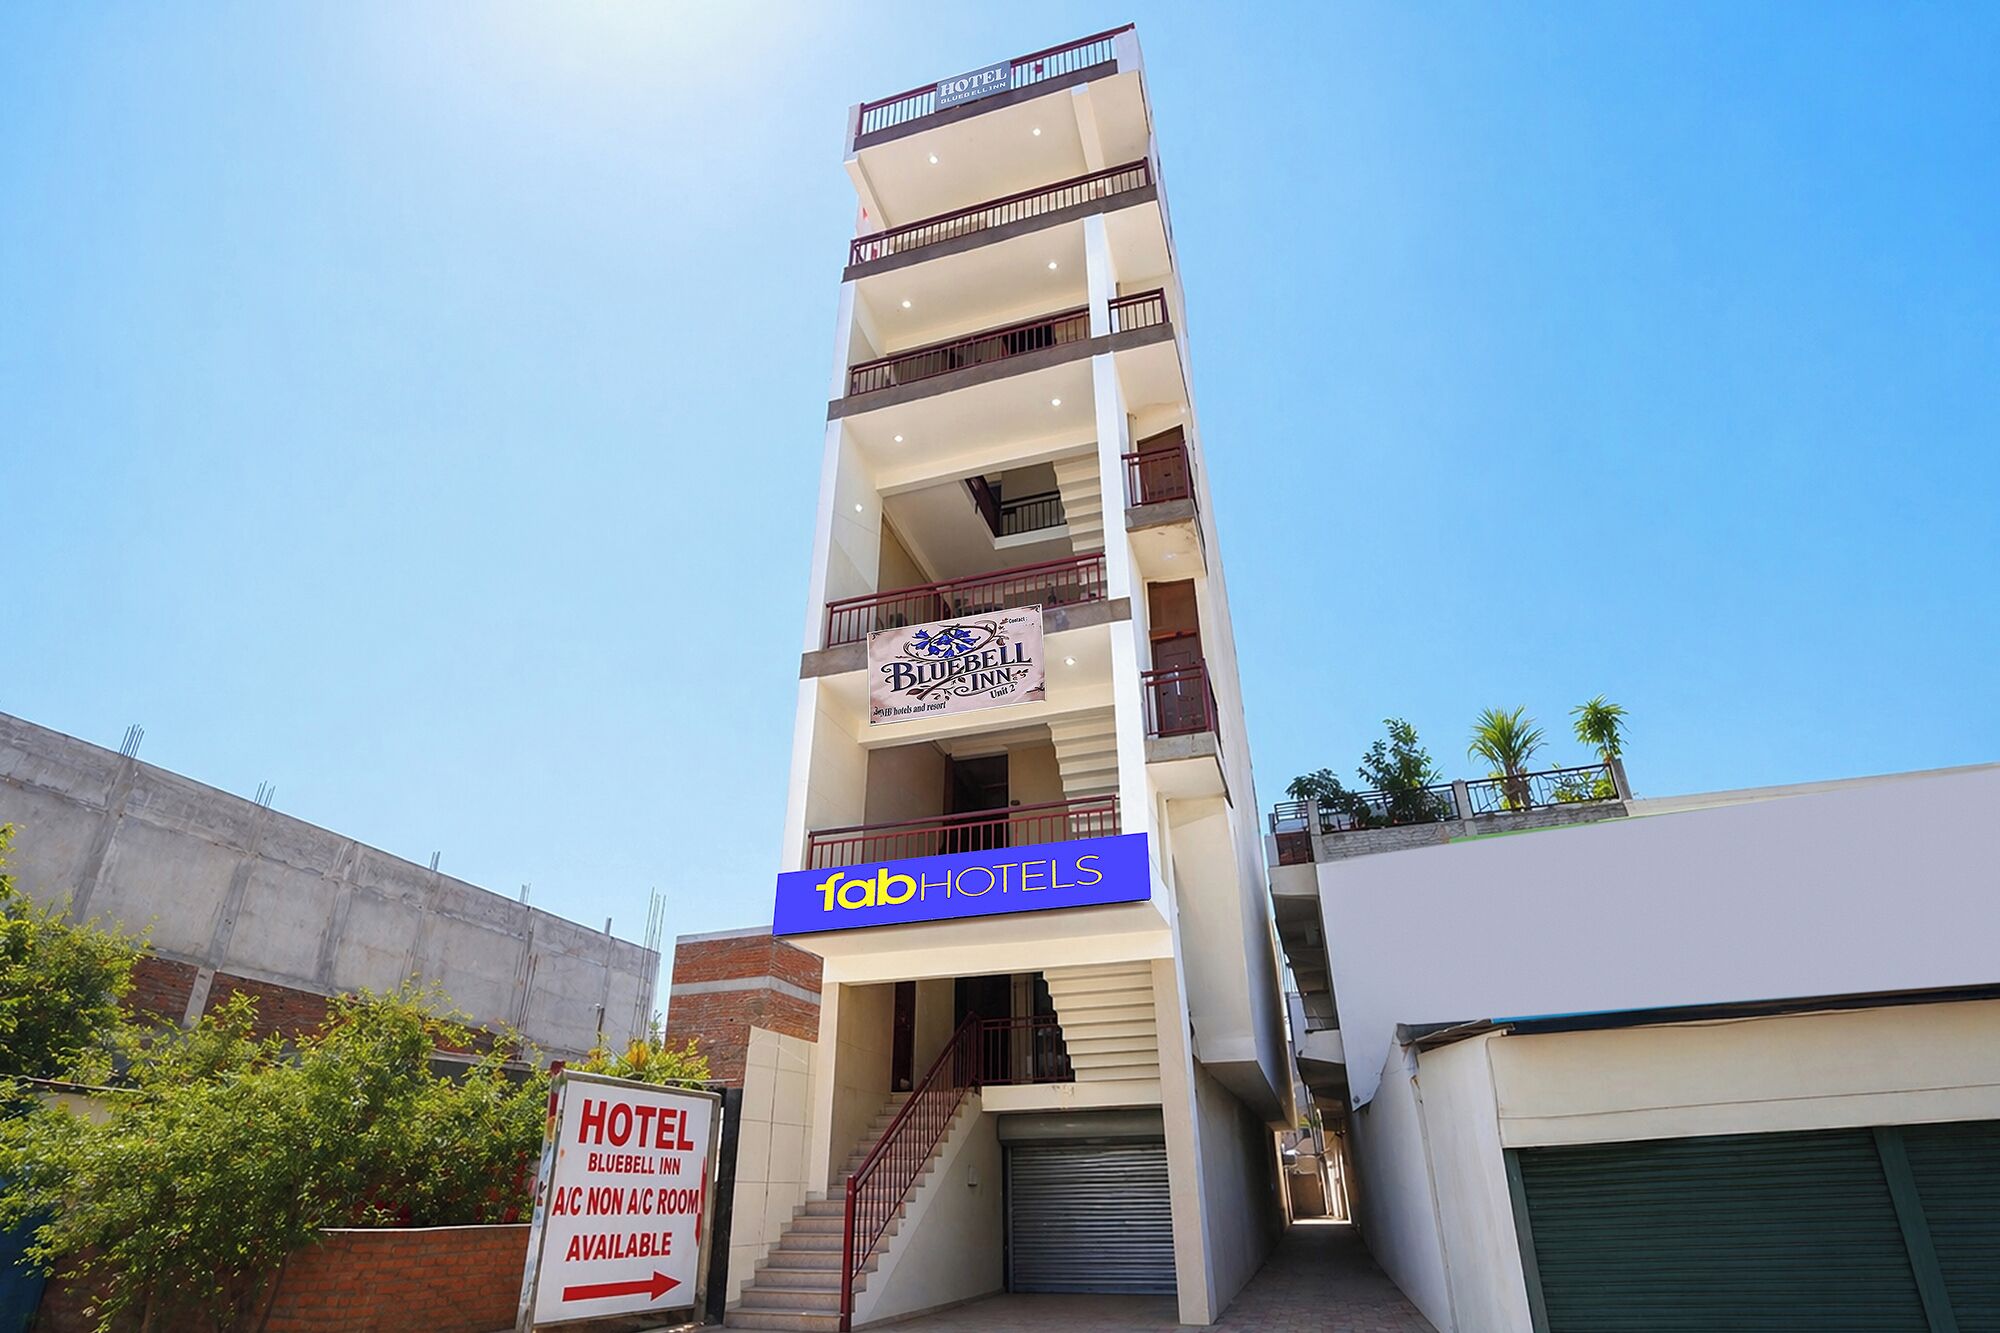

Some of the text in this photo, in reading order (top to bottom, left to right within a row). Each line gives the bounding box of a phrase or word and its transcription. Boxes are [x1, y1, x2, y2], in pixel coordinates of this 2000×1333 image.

[941, 68, 1006, 97] HOTEL
[989, 82, 1006, 91] INN
[881, 642, 1032, 692] BLUEBELL
[971, 667, 1012, 692] INN
[990, 685, 1015, 699] Unit 2
[894, 705, 912, 715] hotels
[913, 703, 926, 713] and
[927, 701, 946, 711] resort
[578, 1099, 694, 1151] HOTEL
[587, 1153, 681, 1175] BLUEBELL INN
[552, 1186, 699, 1216] A/C NON A/C ROOM
[565, 1232, 672, 1262] AVAILABLE
